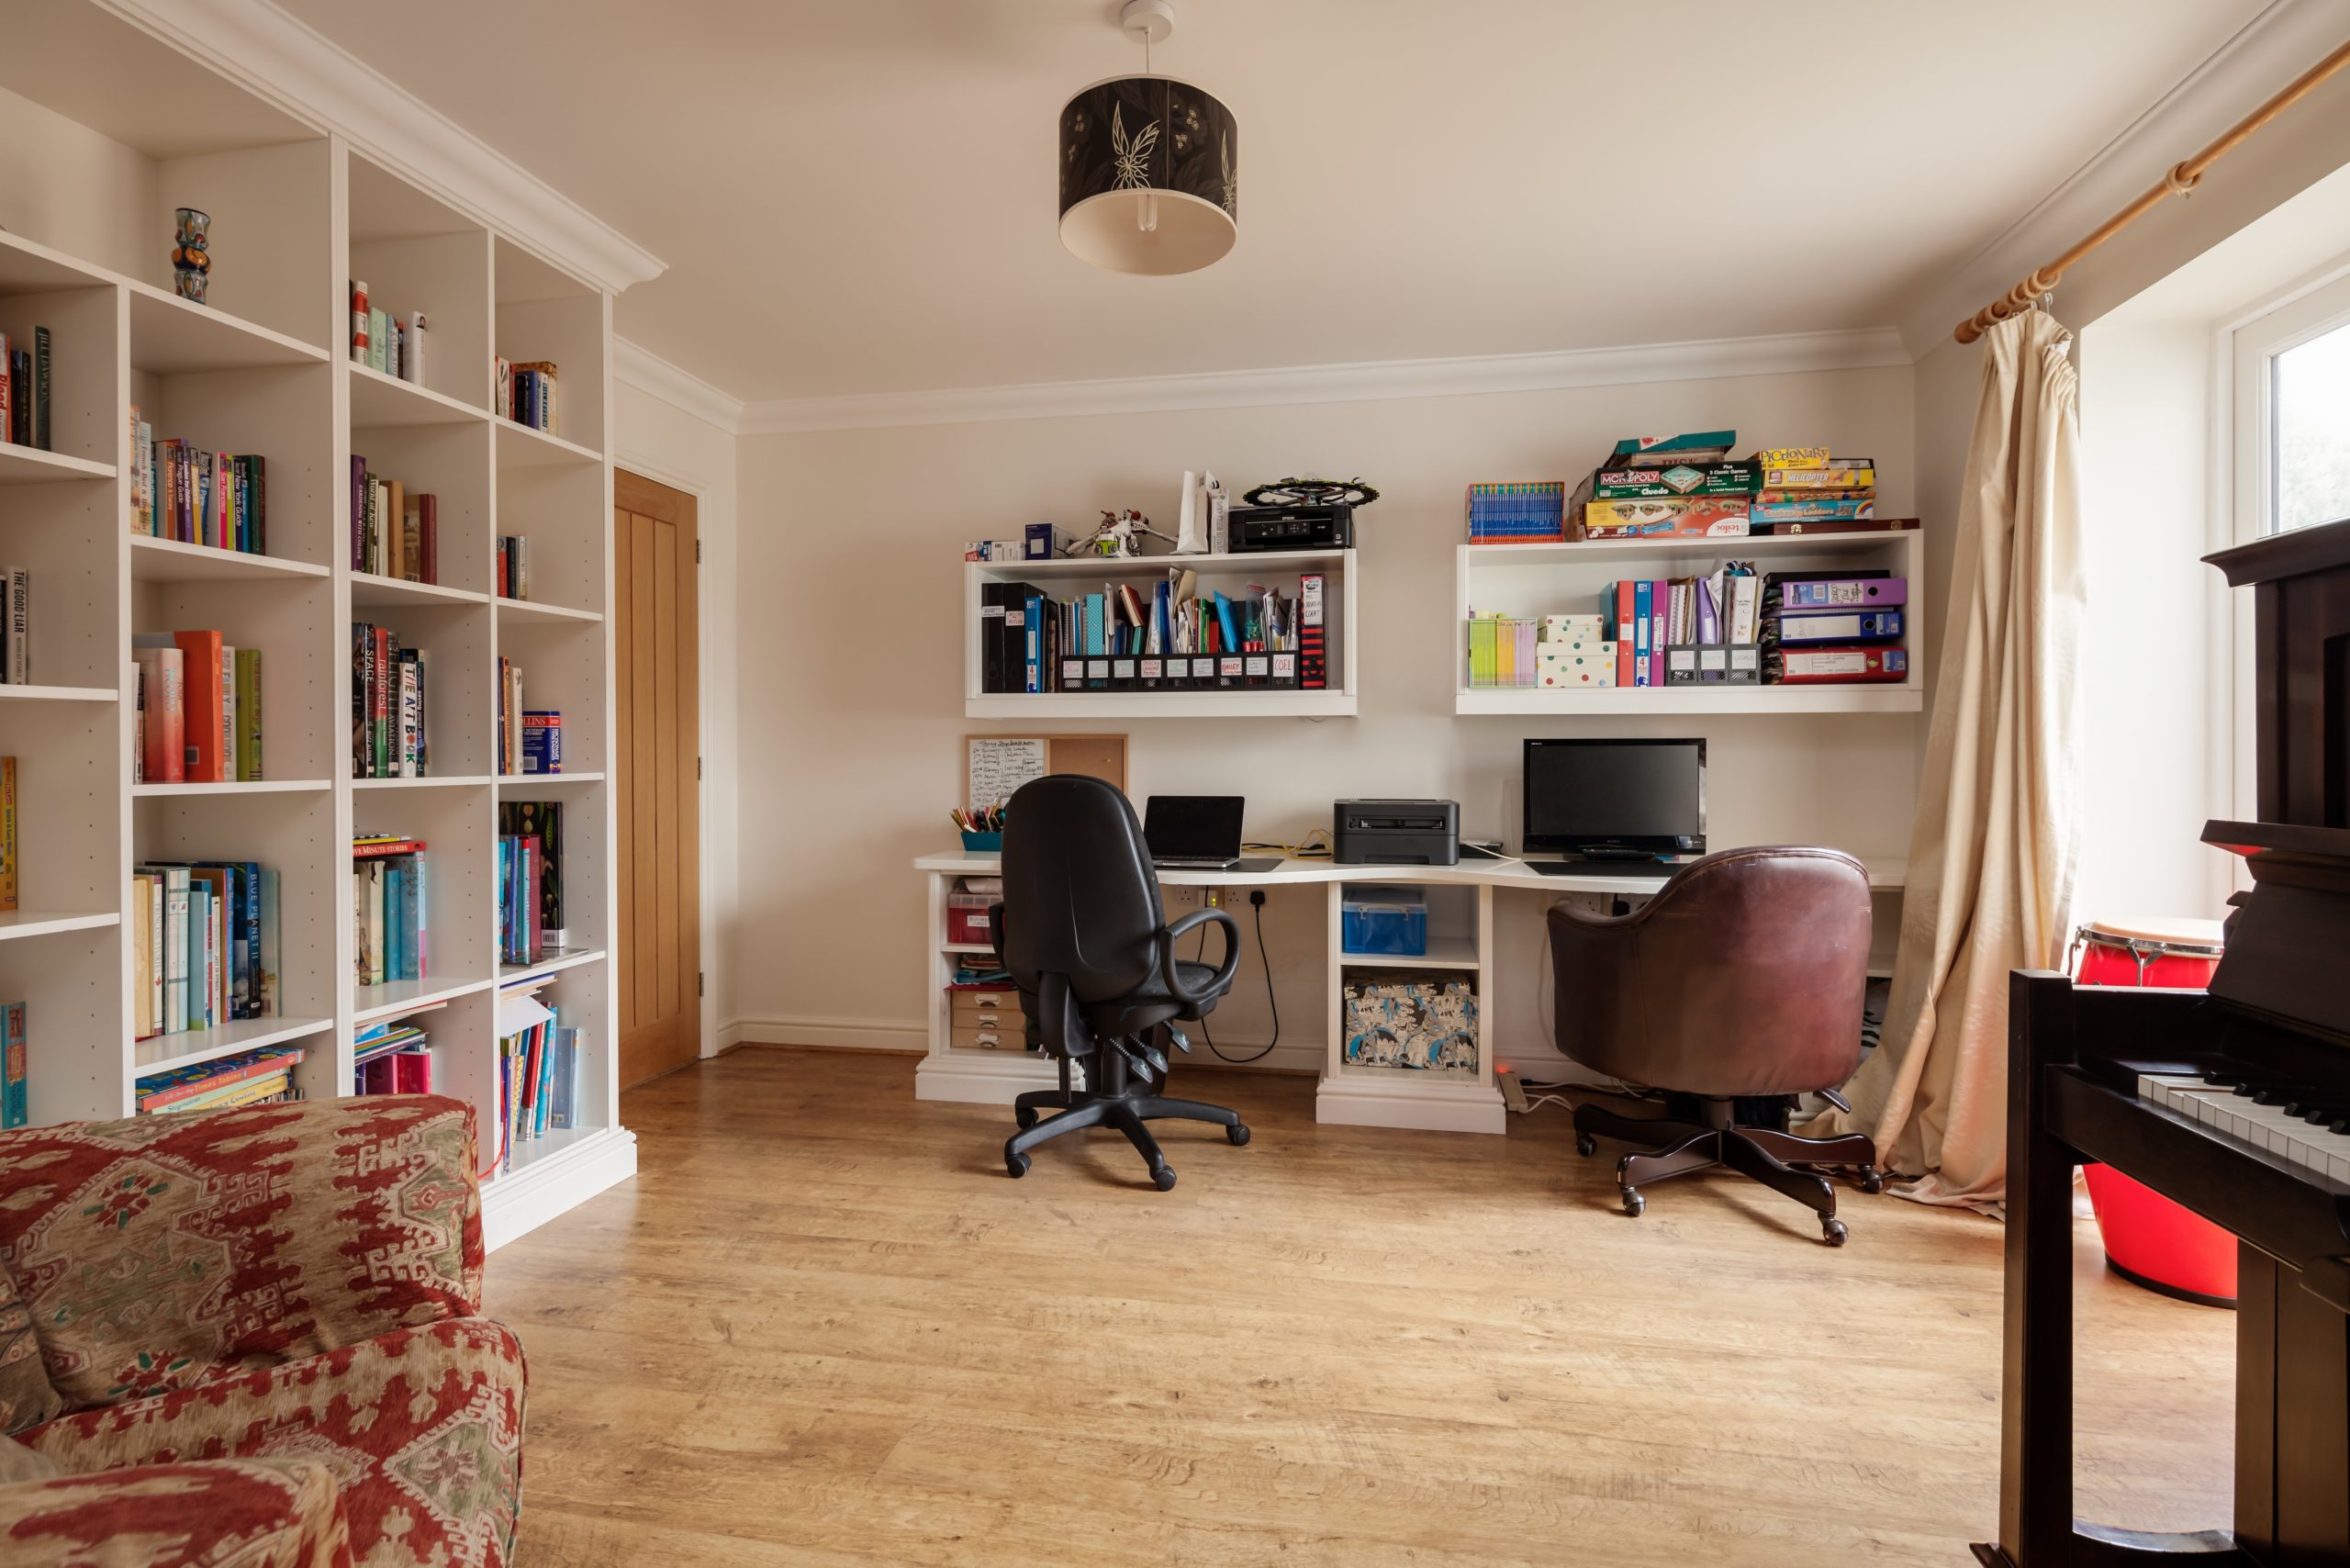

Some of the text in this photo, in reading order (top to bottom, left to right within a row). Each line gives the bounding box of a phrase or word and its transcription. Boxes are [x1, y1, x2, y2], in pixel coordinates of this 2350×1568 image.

[39, 332, 51, 404] JILL DAWSON
[167, 461, 175, 489] Florence
[176, 464, 185, 487] Prague
[1601, 472, 1659, 484] MONOPOLY
[1787, 472, 1830, 483] HELICOPTER
[235, 507, 243, 527] Guide
[14, 571, 26, 633] THE GOOD LIAR
[366, 650, 375, 683] SPACE
[1274, 659, 1292, 671] COEL
[377, 658, 388, 710] rainforest
[522, 717, 546, 726] LLINS
[387, 713, 397, 756] AVIATION
[363, 844, 386, 854] MINUTE
[386, 842, 409, 853] STORIES
[154, 902, 162, 974] PRINCESS STORIES
[251, 905, 259, 947] PLANET
[194, 1080, 218, 1094] Times
[218, 1071, 243, 1088] Tables
